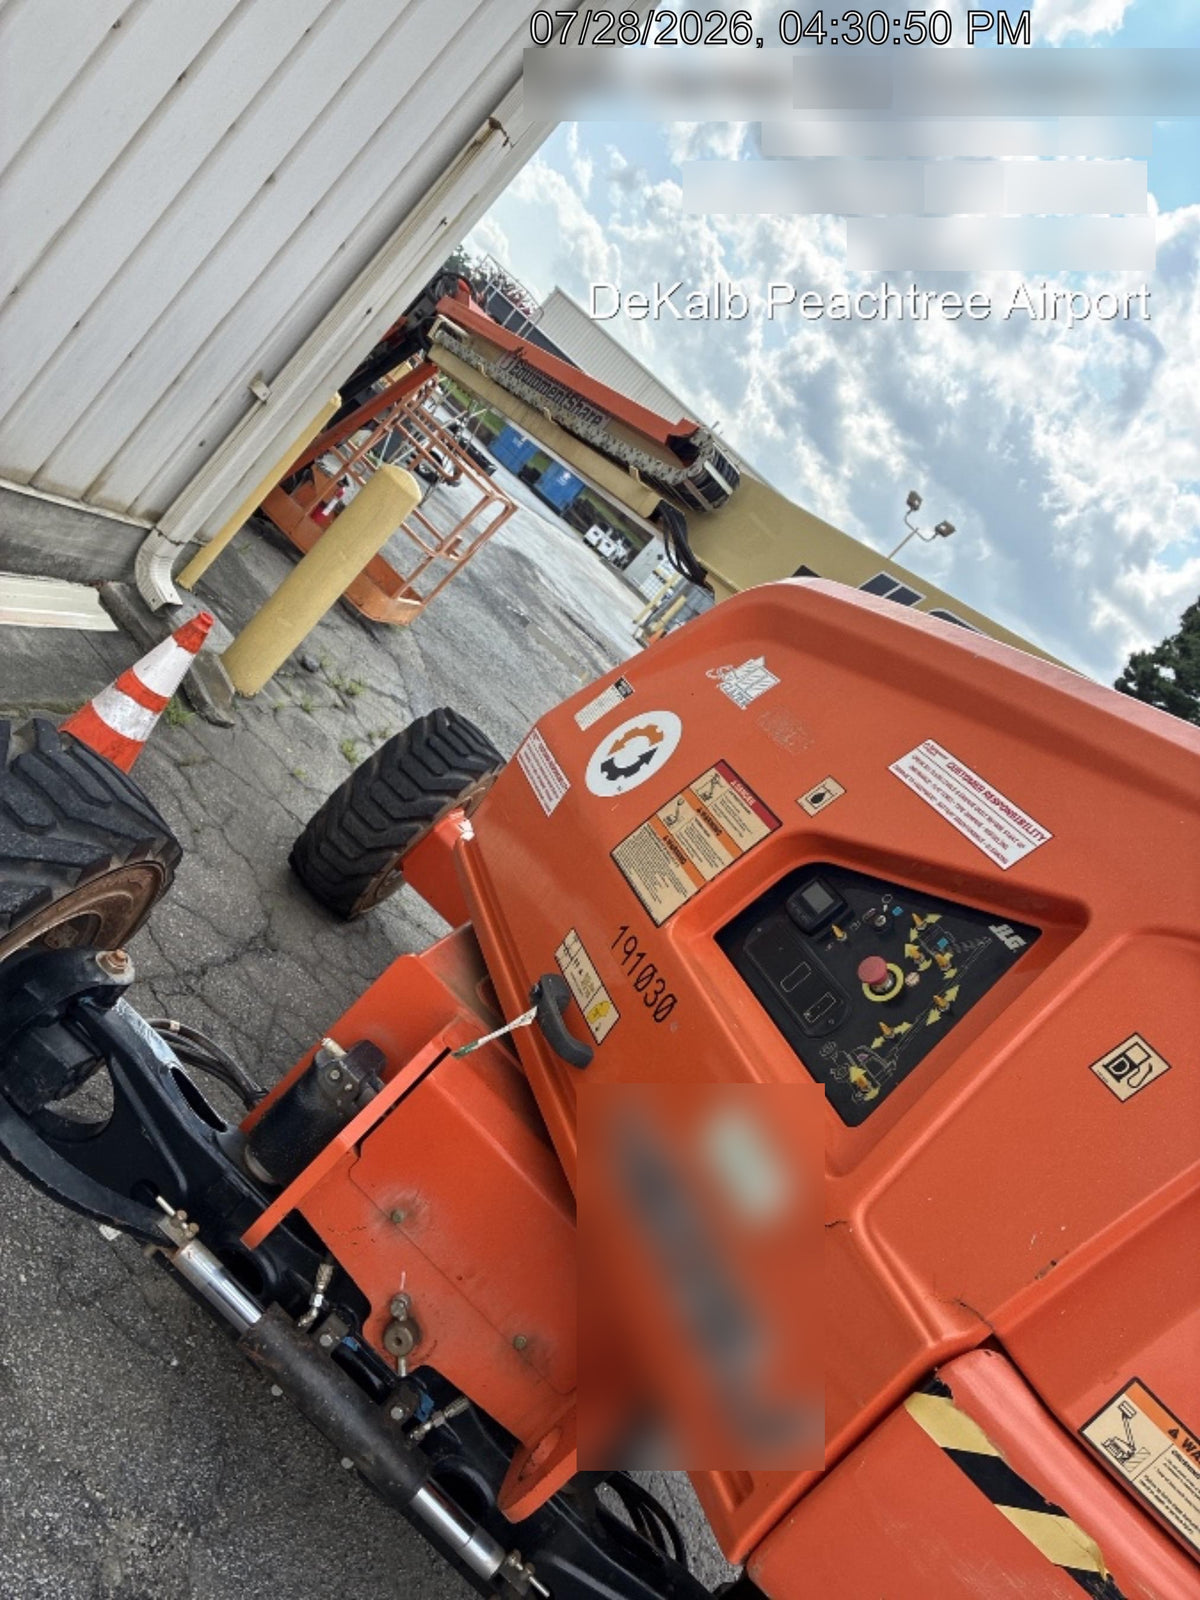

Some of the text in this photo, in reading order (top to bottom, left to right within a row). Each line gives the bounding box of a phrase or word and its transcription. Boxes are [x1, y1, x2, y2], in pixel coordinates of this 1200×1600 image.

[988, 924, 1027, 951] JLG
[611, 926, 678, 1023] 191030
[1182, 1437, 1200, 1464] WA
